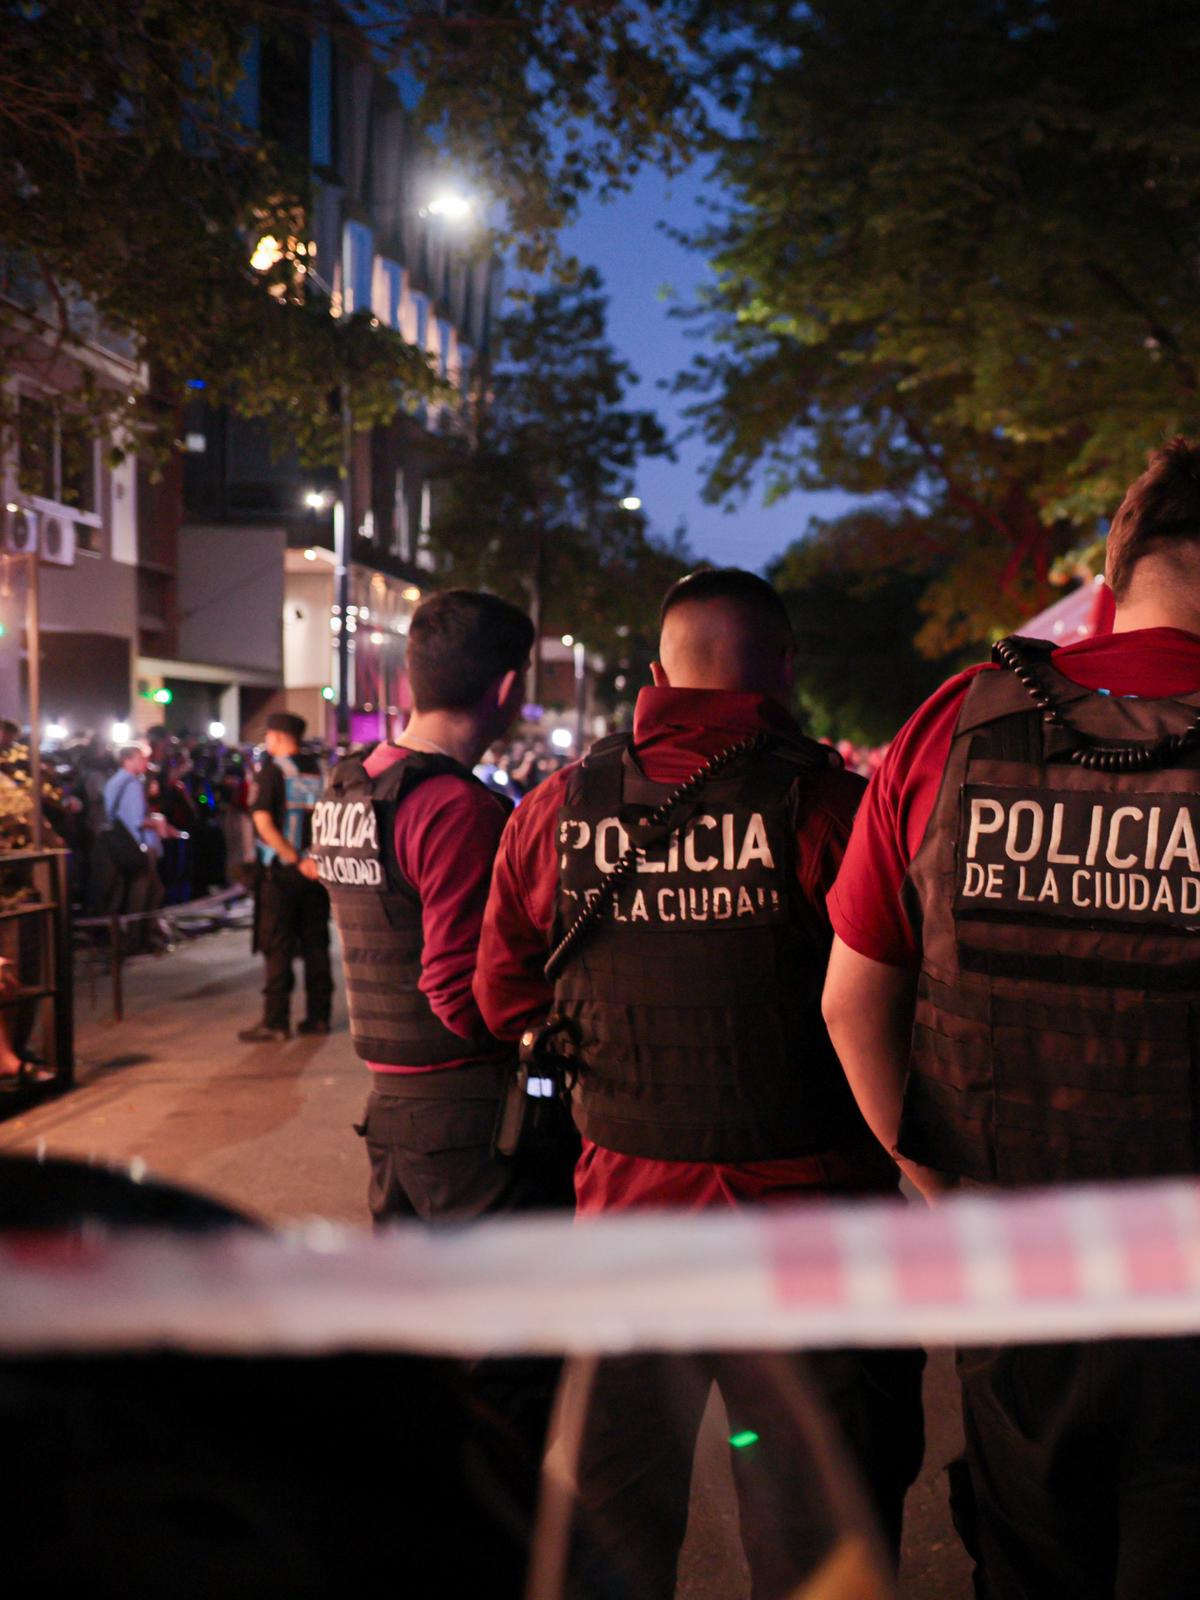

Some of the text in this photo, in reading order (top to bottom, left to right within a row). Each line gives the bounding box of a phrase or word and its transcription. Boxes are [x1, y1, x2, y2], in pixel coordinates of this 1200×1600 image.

[962, 862, 1005, 898] DE
[1018, 866, 1060, 904] LA
[612, 887, 649, 922] LA
